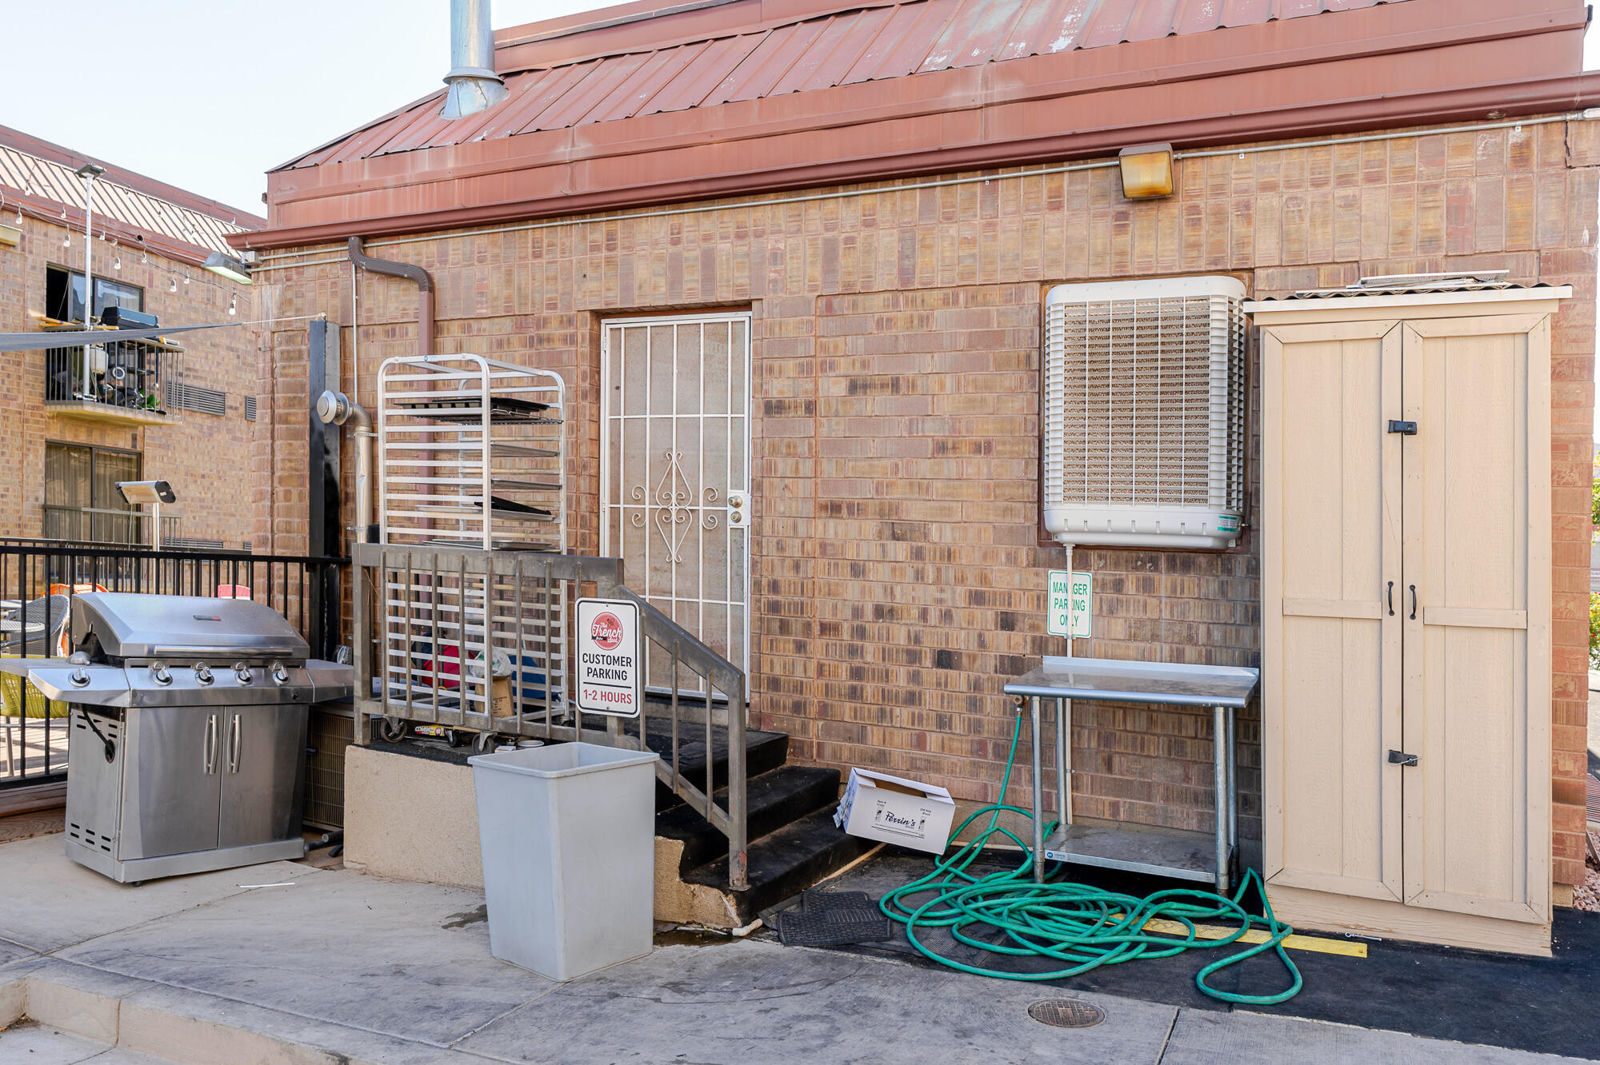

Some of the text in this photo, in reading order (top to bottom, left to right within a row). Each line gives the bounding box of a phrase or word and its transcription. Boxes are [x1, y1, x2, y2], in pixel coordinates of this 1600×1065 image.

[1053, 582, 1088, 595] MANGER
[1054, 598, 1085, 611] PARING
[592, 624, 622, 638] French
[582, 653, 632, 667] CUSTOMER
[587, 667, 628, 681] PARKING
[583, 689, 632, 704] 1-2 HOURS
[885, 811, 916, 826] Perrin's
